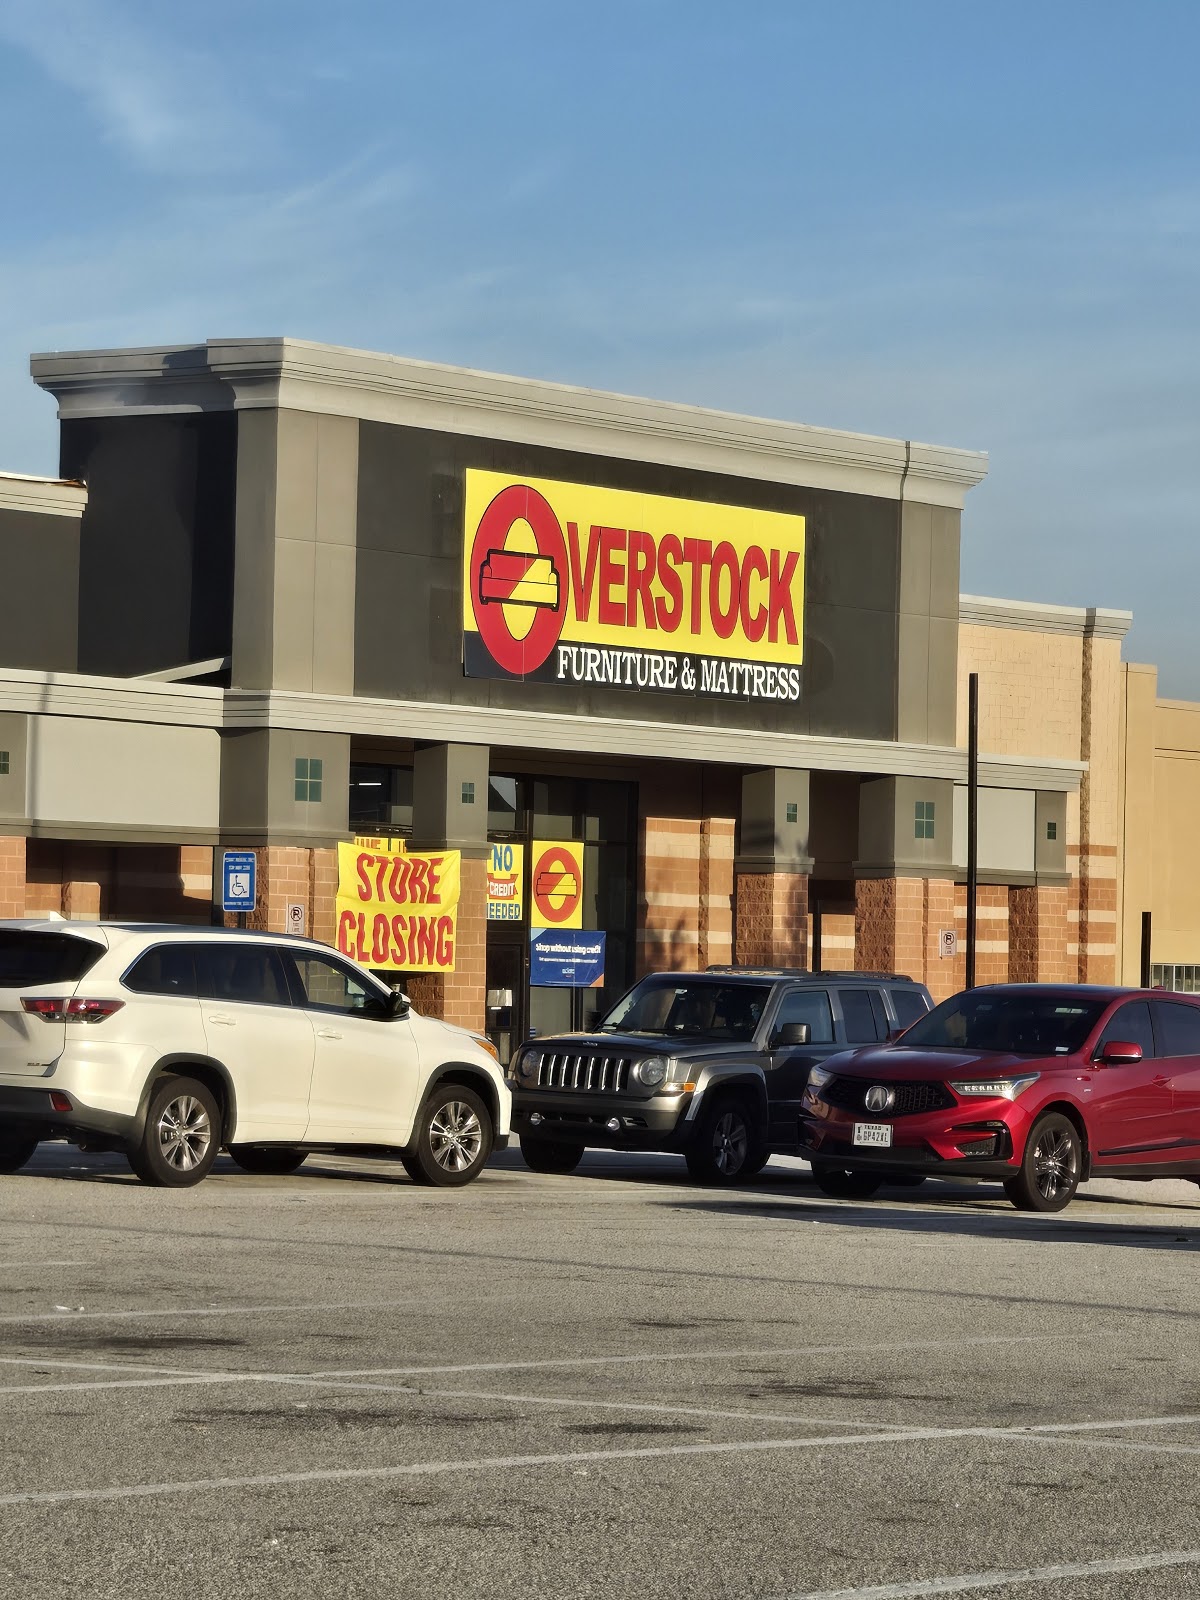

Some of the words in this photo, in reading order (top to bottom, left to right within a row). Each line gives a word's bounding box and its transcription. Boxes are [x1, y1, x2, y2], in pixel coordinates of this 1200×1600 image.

[557, 645, 678, 690] FURNITURE
[681, 657, 697, 690] &
[700, 659, 800, 700] MATTRESS
[356, 852, 444, 904] STORE
[493, 844, 513, 872] NO
[489, 881, 515, 897] CREDIT
[338, 909, 454, 966] CLOSING
[535, 943, 550, 953] Shop
